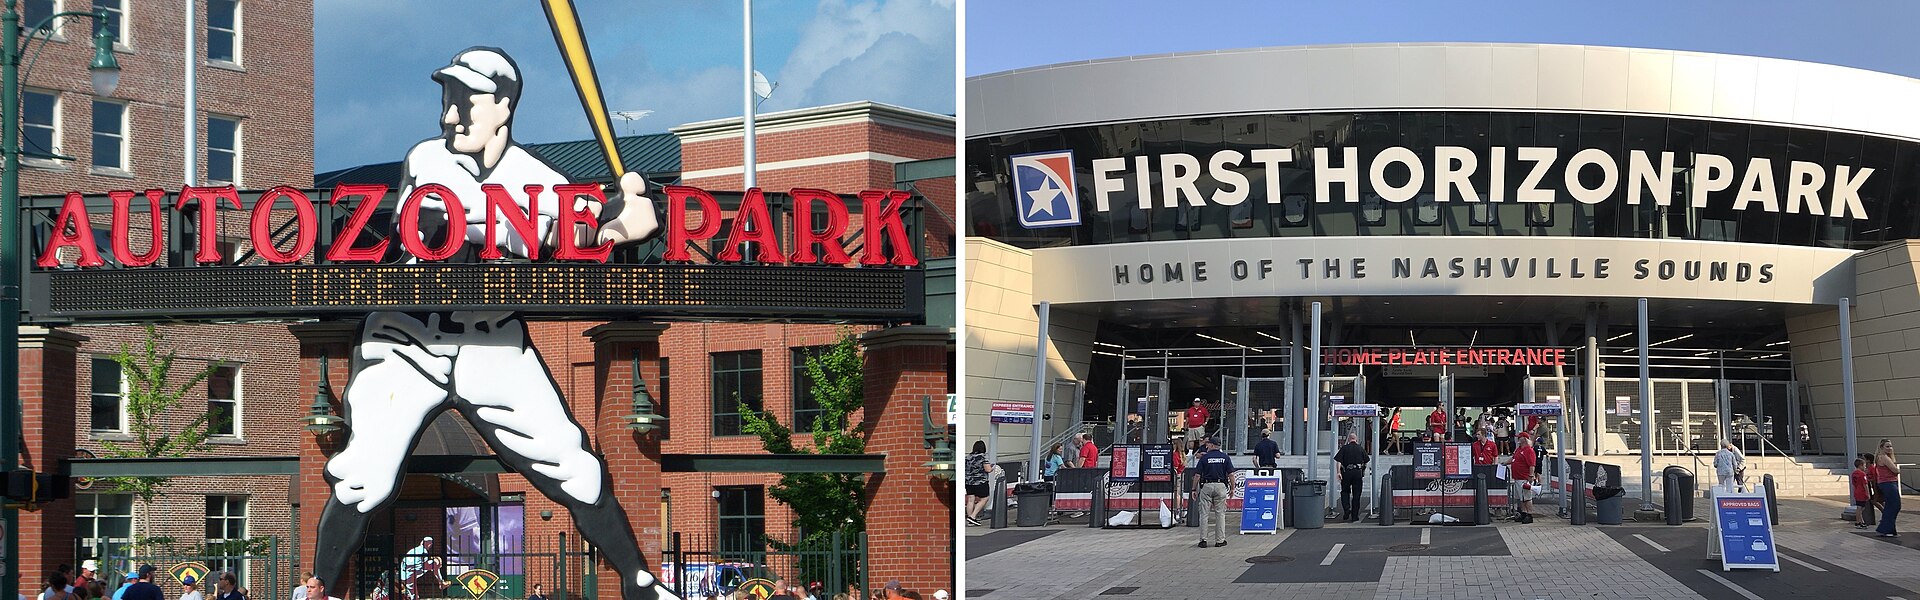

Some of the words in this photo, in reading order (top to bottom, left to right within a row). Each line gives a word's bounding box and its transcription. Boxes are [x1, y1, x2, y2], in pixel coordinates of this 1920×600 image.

[1092, 149, 1293, 212] FIRST
[1313, 146, 1675, 206] HORIZON
[1691, 153, 1876, 220] PARK
[36, 182, 615, 268] AUTOZONE
[662, 185, 918, 266] PARK
[281, 267, 457, 306] TICKETS
[484, 267, 705, 305] AVAILABLE
[1113, 260, 1207, 285] HOME
[1231, 259, 1273, 280] OF
[1297, 257, 1367, 280] THE
[1391, 256, 1611, 279] NASHVILLE
[1633, 258, 1774, 284] SOUNDS
[1324, 349, 1383, 365] HOME
[1388, 349, 1451, 365] PLATE
[1455, 349, 1567, 365] ENTRANCE
